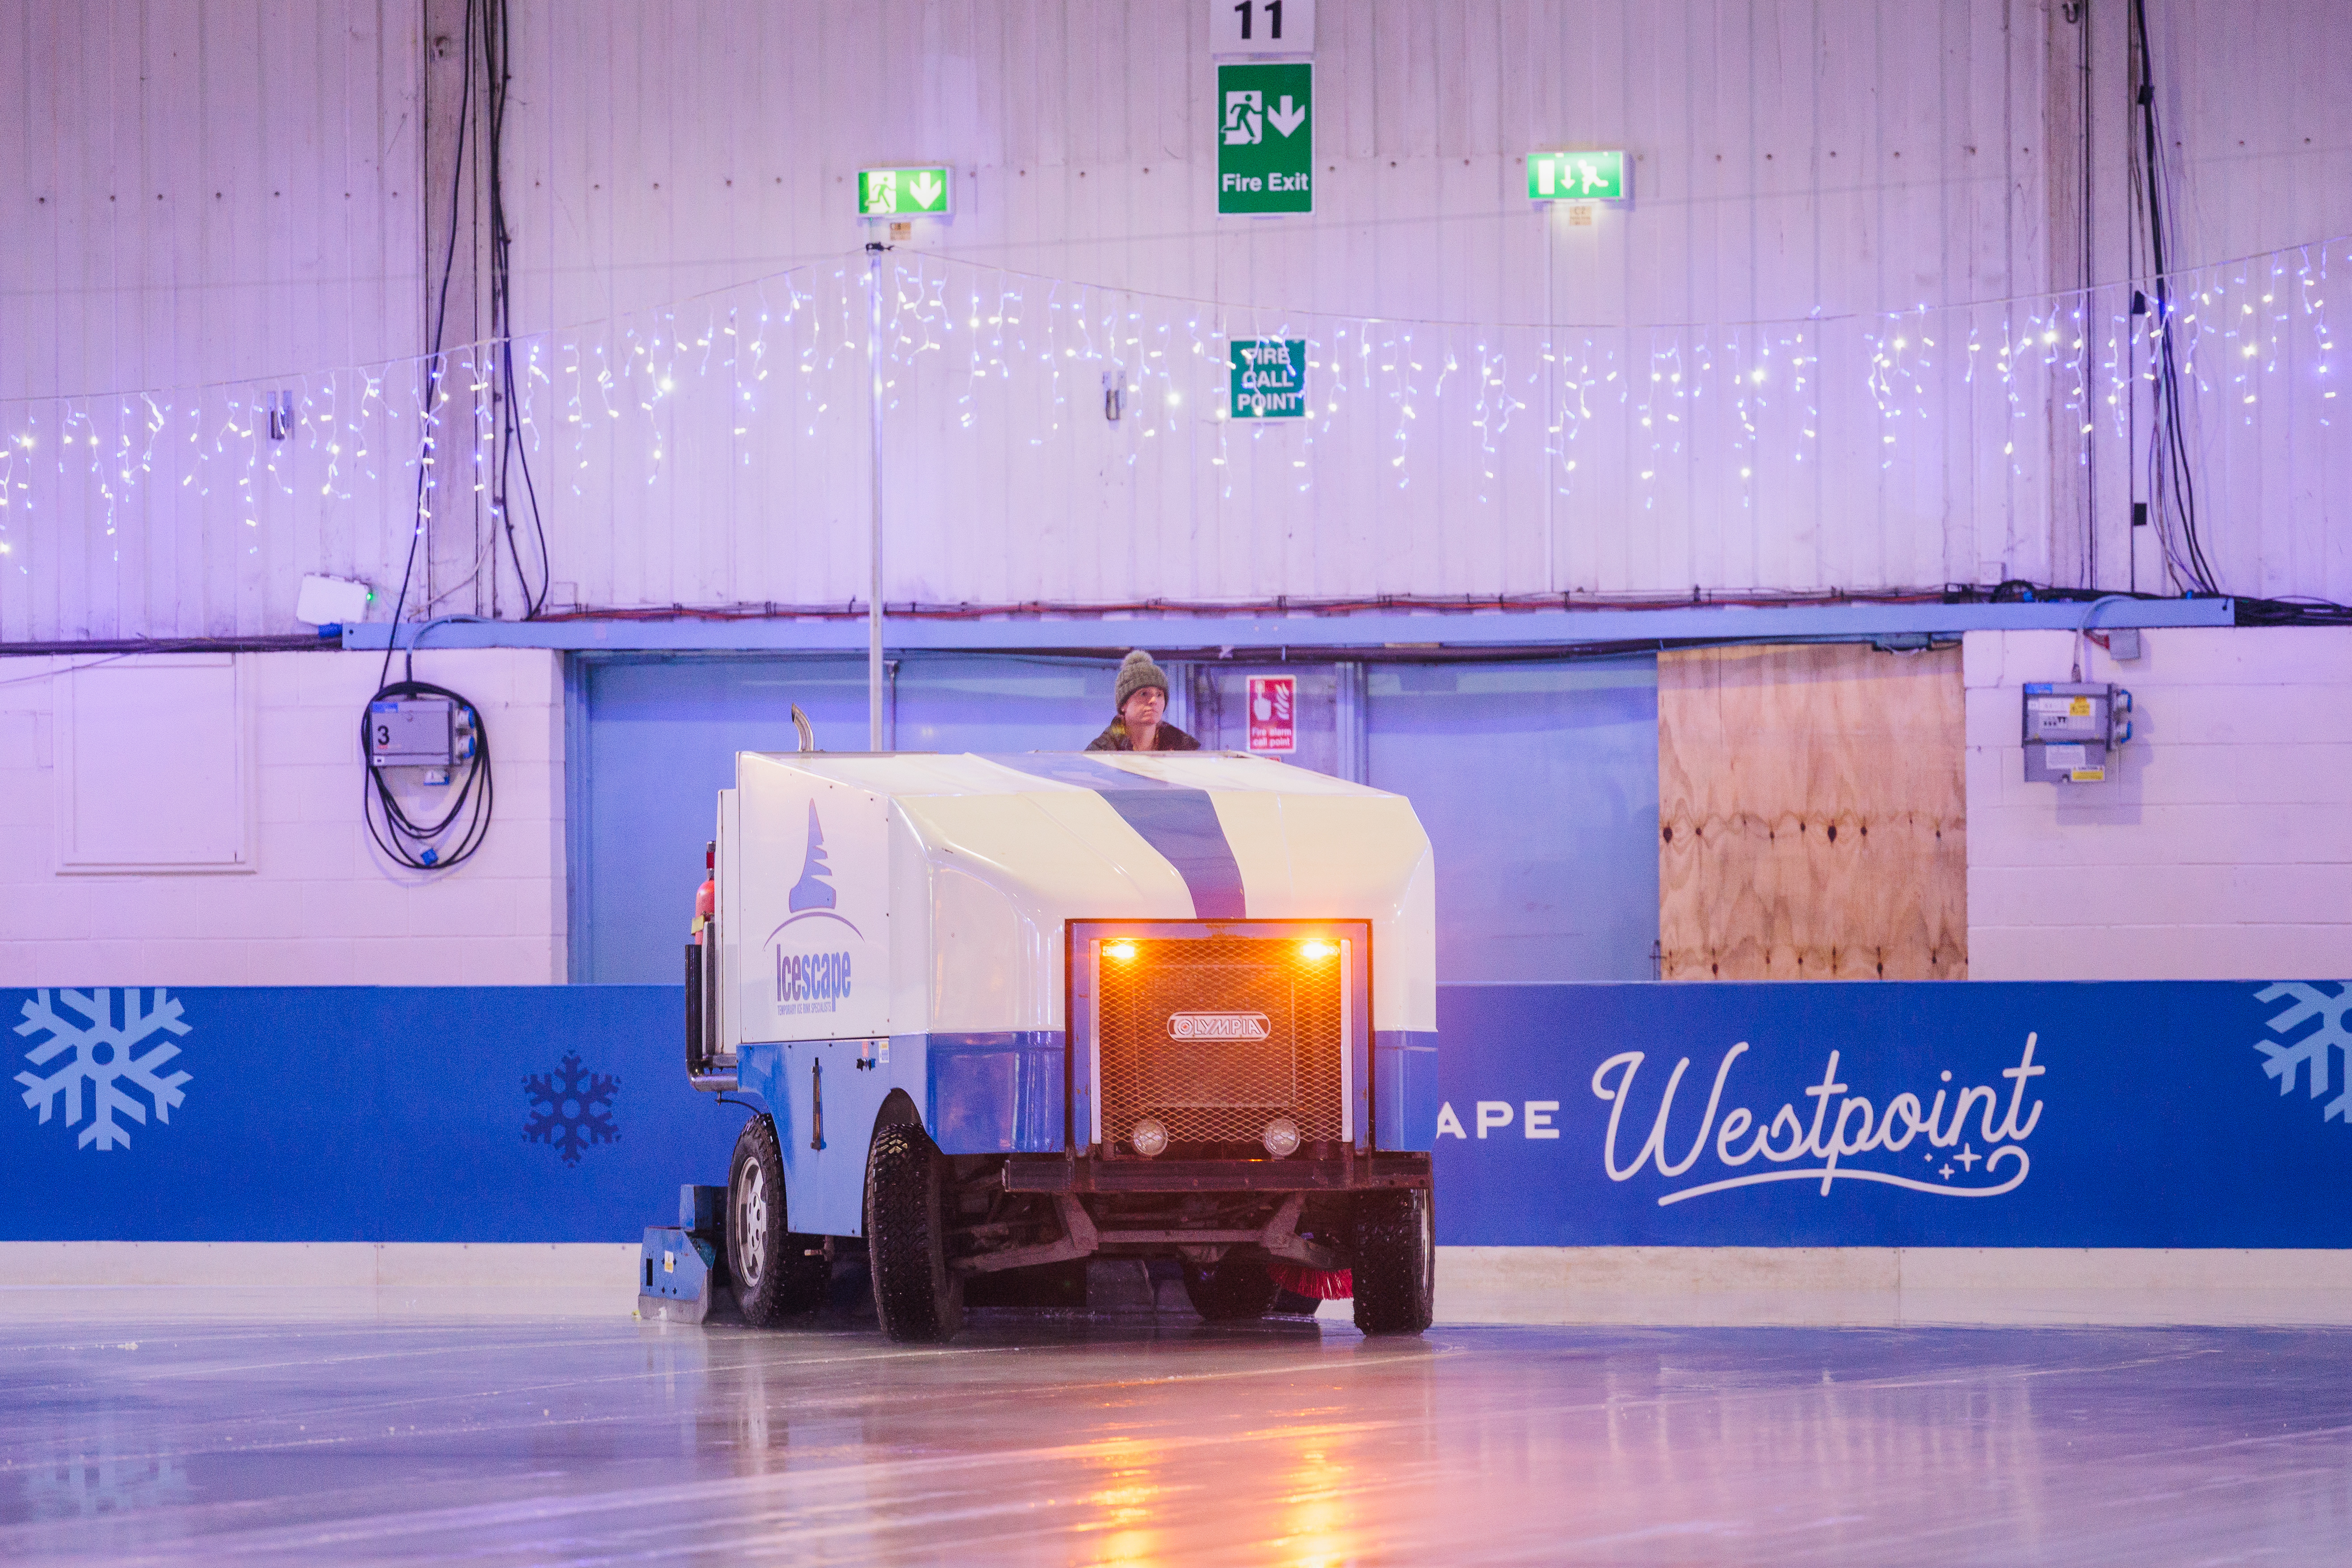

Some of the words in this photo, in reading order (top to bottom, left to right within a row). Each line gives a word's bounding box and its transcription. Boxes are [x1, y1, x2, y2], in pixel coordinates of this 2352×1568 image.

[1235, 0, 1281, 39] 11
[1222, 173, 1262, 192] Fire
[1268, 172, 1309, 191] Exit
[1237, 392, 1297, 411] POINT
[378, 725, 390, 745] 3
[1252, 727, 1267, 736] Fire
[1269, 727, 1292, 736] alarm
[1253, 737, 1268, 746] call
[1269, 738, 1290, 747] point
[777, 944, 851, 1012] Icescape
[1178, 1018, 1261, 1035] OLYMPIA
[1592, 1031, 2046, 1198] Westpoint
